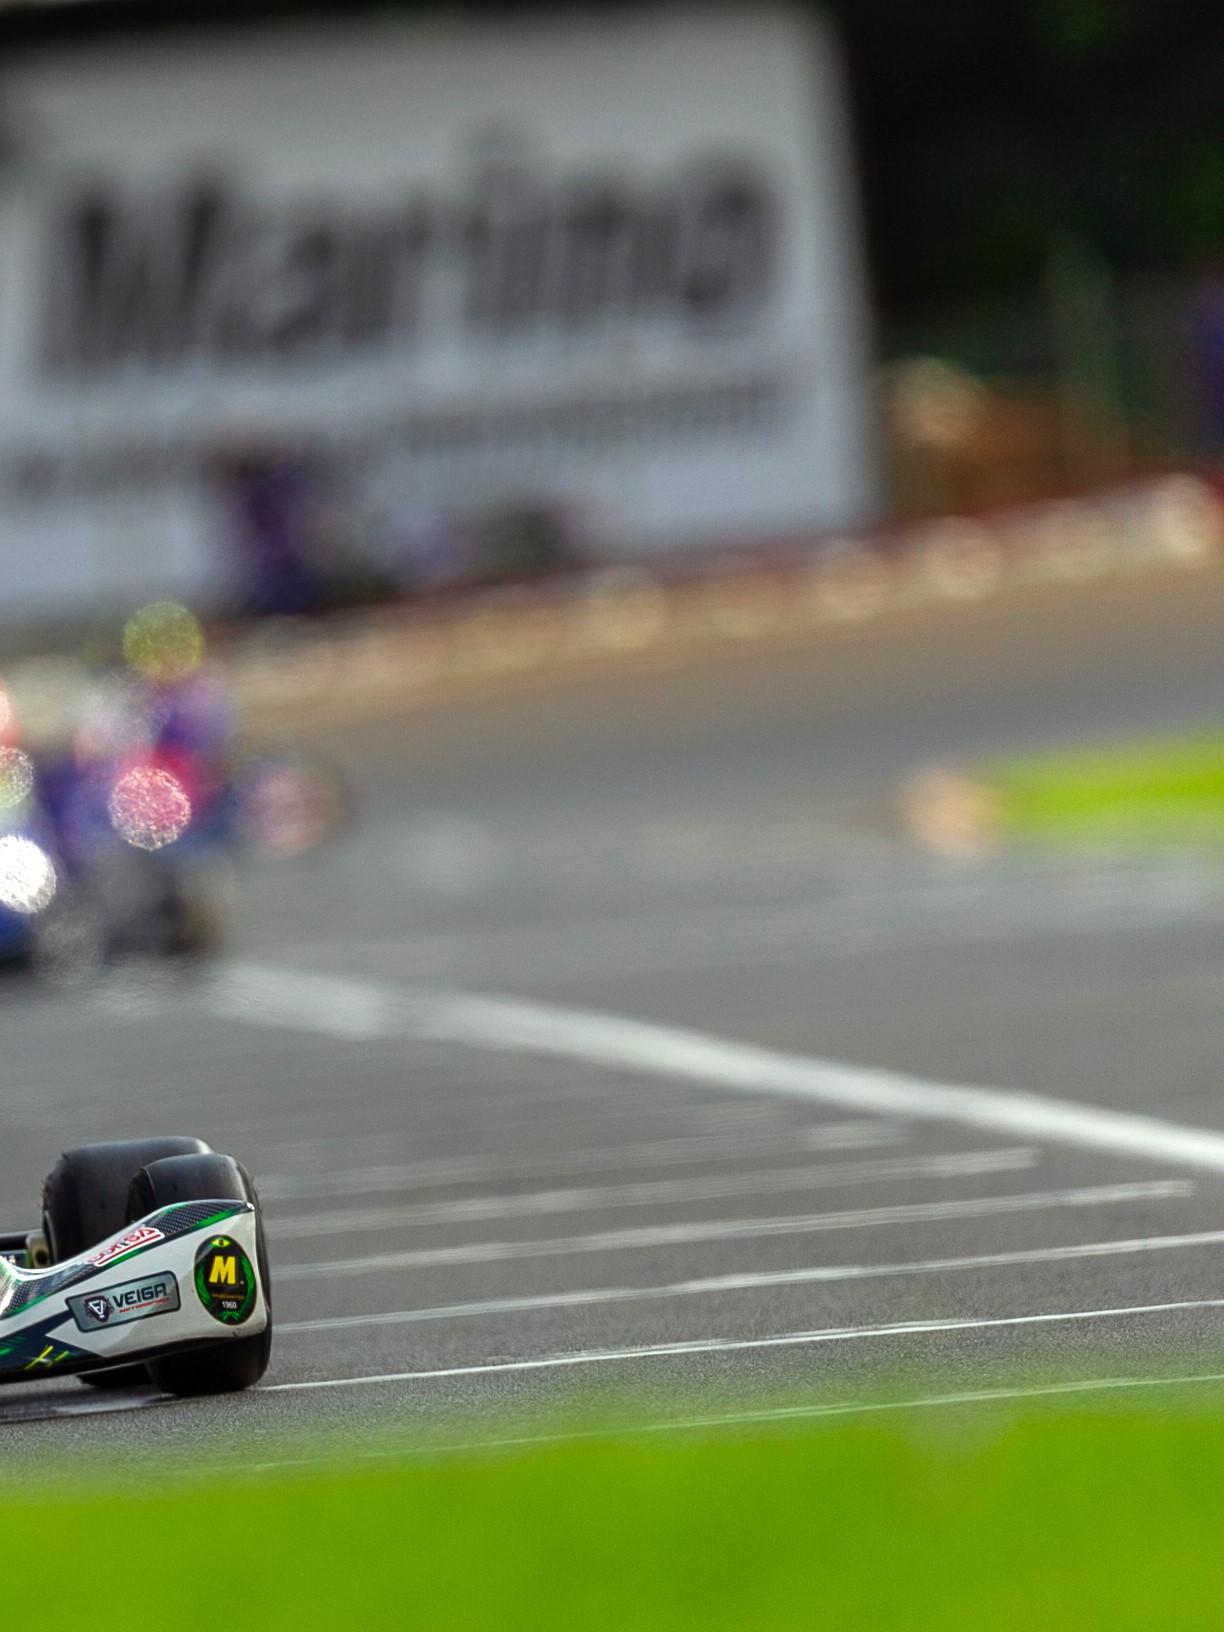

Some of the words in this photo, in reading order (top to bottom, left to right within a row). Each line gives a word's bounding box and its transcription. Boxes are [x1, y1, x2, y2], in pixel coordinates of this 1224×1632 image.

[42, 135, 782, 375] Marino
[209, 1256, 236, 1285] M
[112, 1282, 167, 1307] VEIGA
[222, 1301, 237, 1309] 1960
